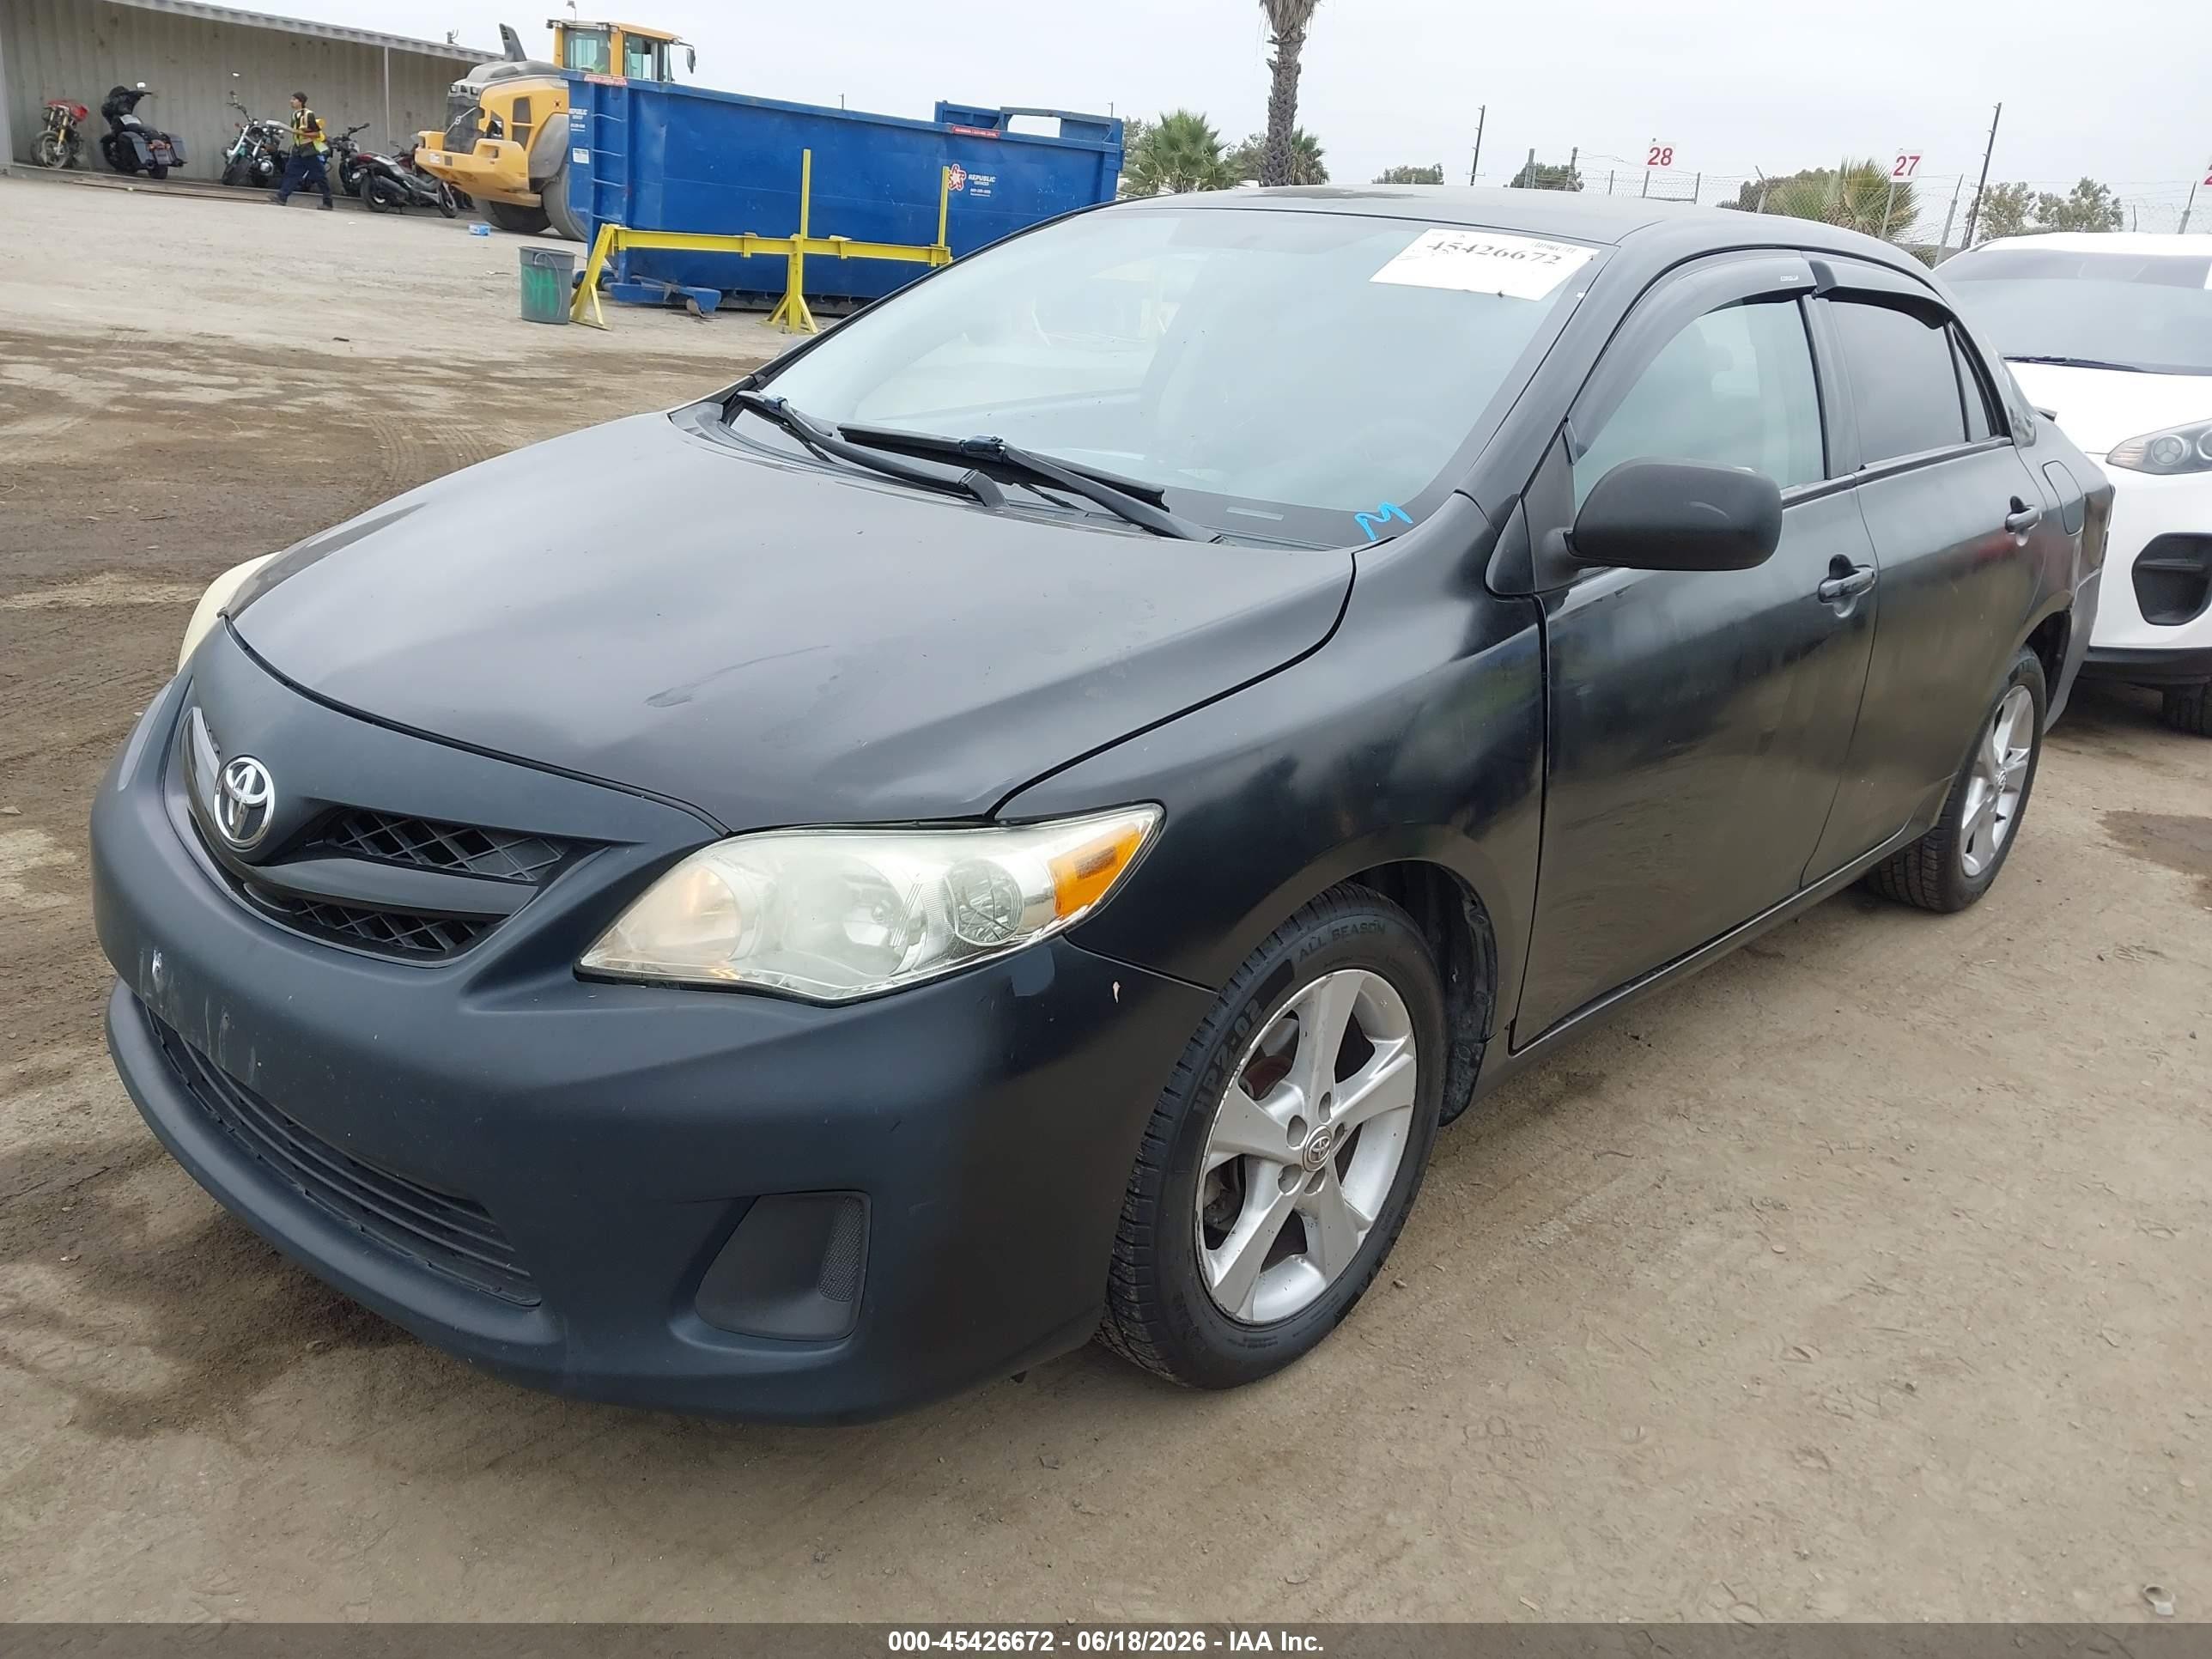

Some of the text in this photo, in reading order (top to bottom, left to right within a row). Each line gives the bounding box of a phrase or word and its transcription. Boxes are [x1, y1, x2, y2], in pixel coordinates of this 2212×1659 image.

[1647, 147, 1674, 166] 28
[1893, 155, 1921, 176] 27
[968, 173, 997, 183] REPUBLIC
[1426, 240, 1563, 264] 45426672
[1299, 935, 1328, 963] ALL
[1332, 920, 1387, 942] SEASON
